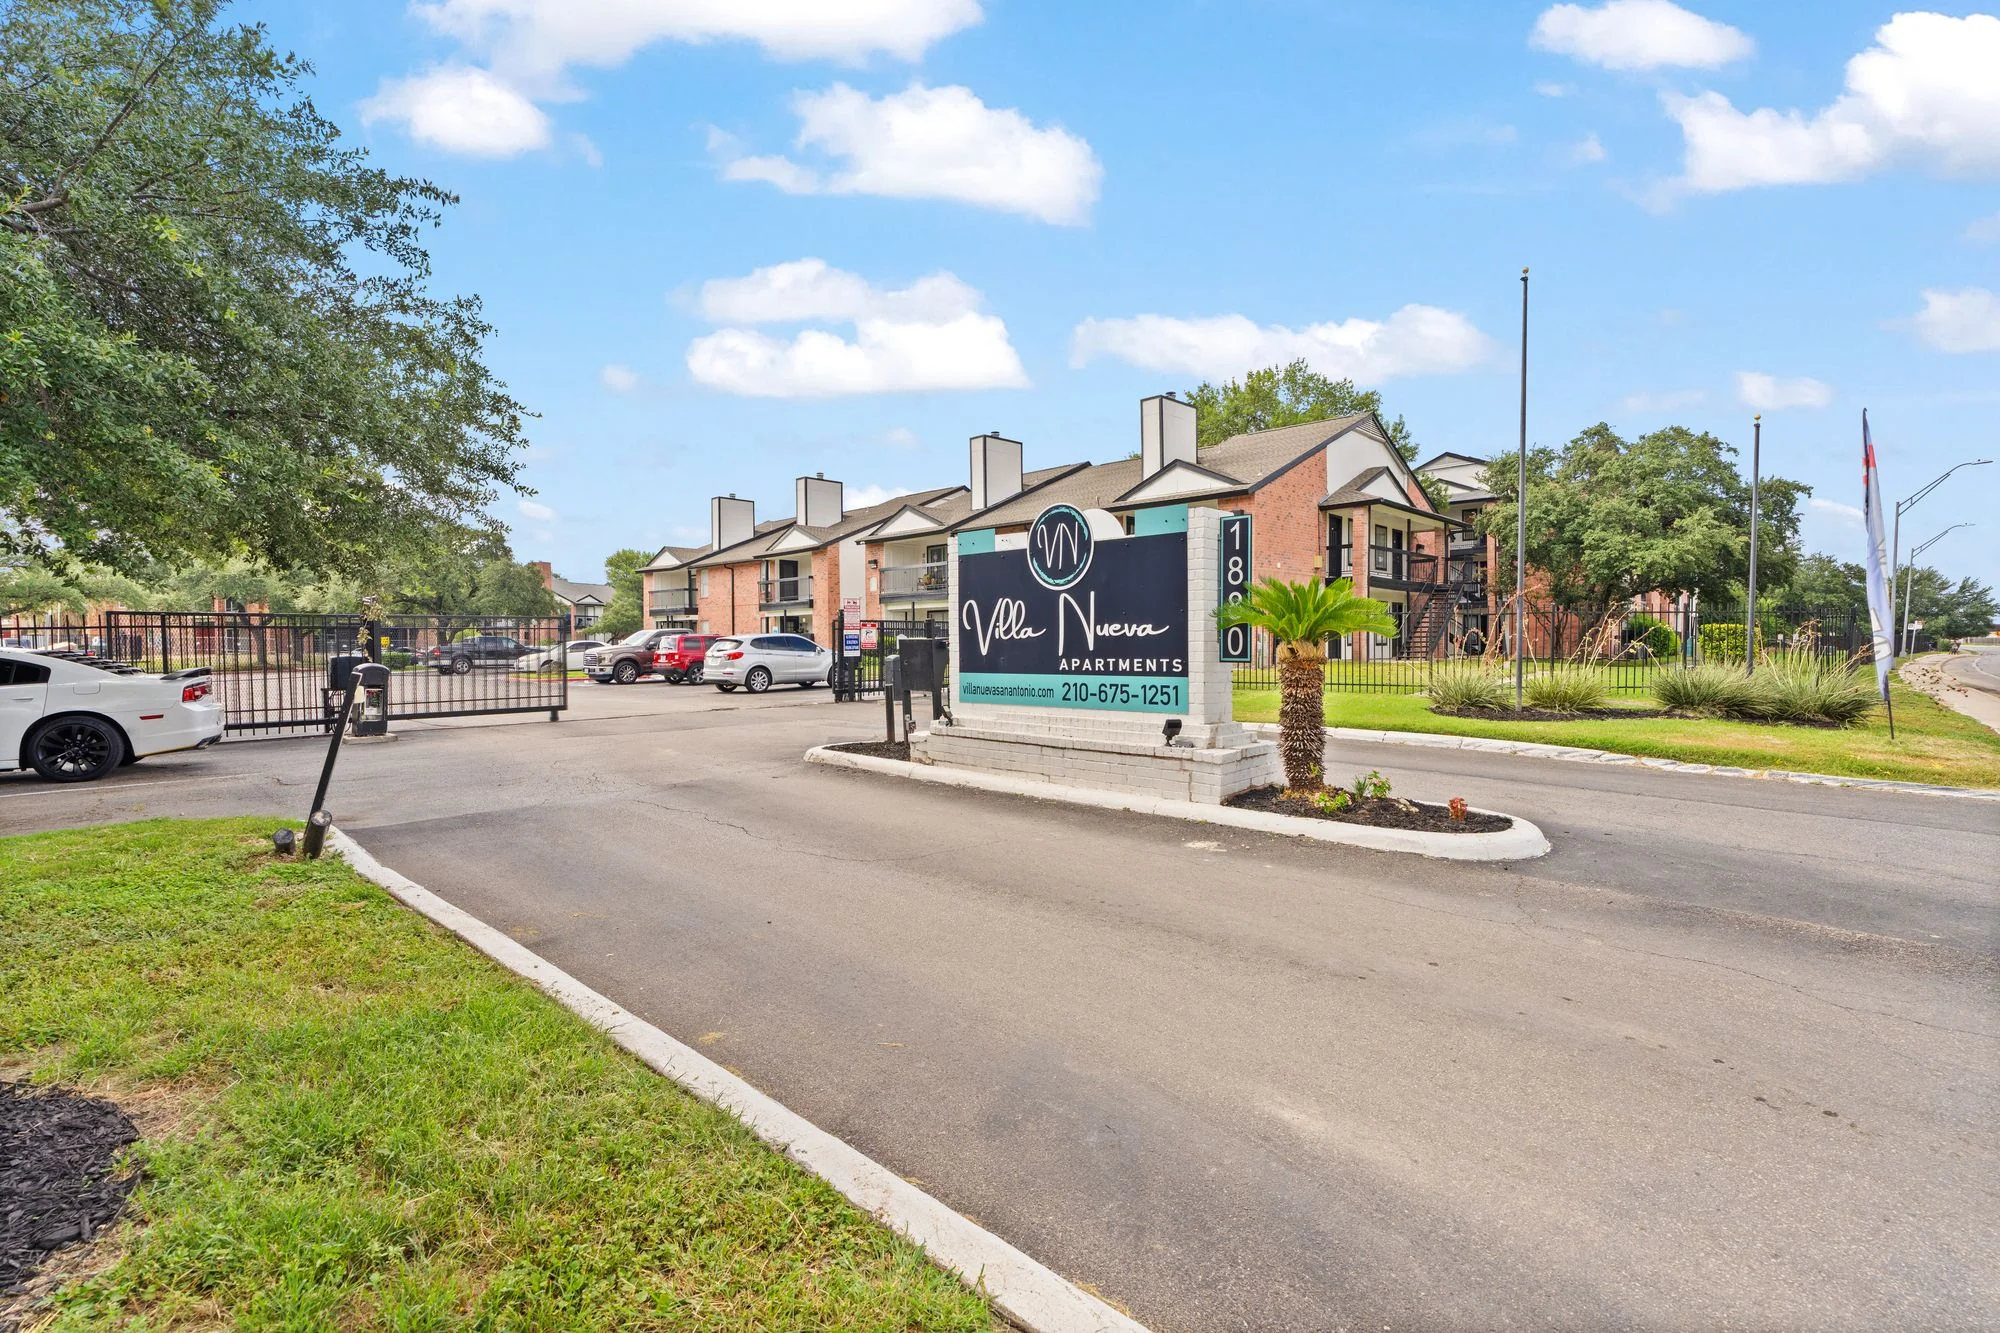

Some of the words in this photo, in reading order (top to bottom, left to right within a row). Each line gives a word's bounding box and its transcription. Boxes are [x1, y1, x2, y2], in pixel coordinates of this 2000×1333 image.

[1227, 520, 1244, 656] 1880
[962, 597, 1046, 656] Villa
[1058, 590, 1170, 657] Nueva
[1059, 658, 1183, 672] APARTMENTS
[962, 682, 1055, 699] villanuevasanantonio.com
[1061, 682, 1180, 706] 210-675-1251
